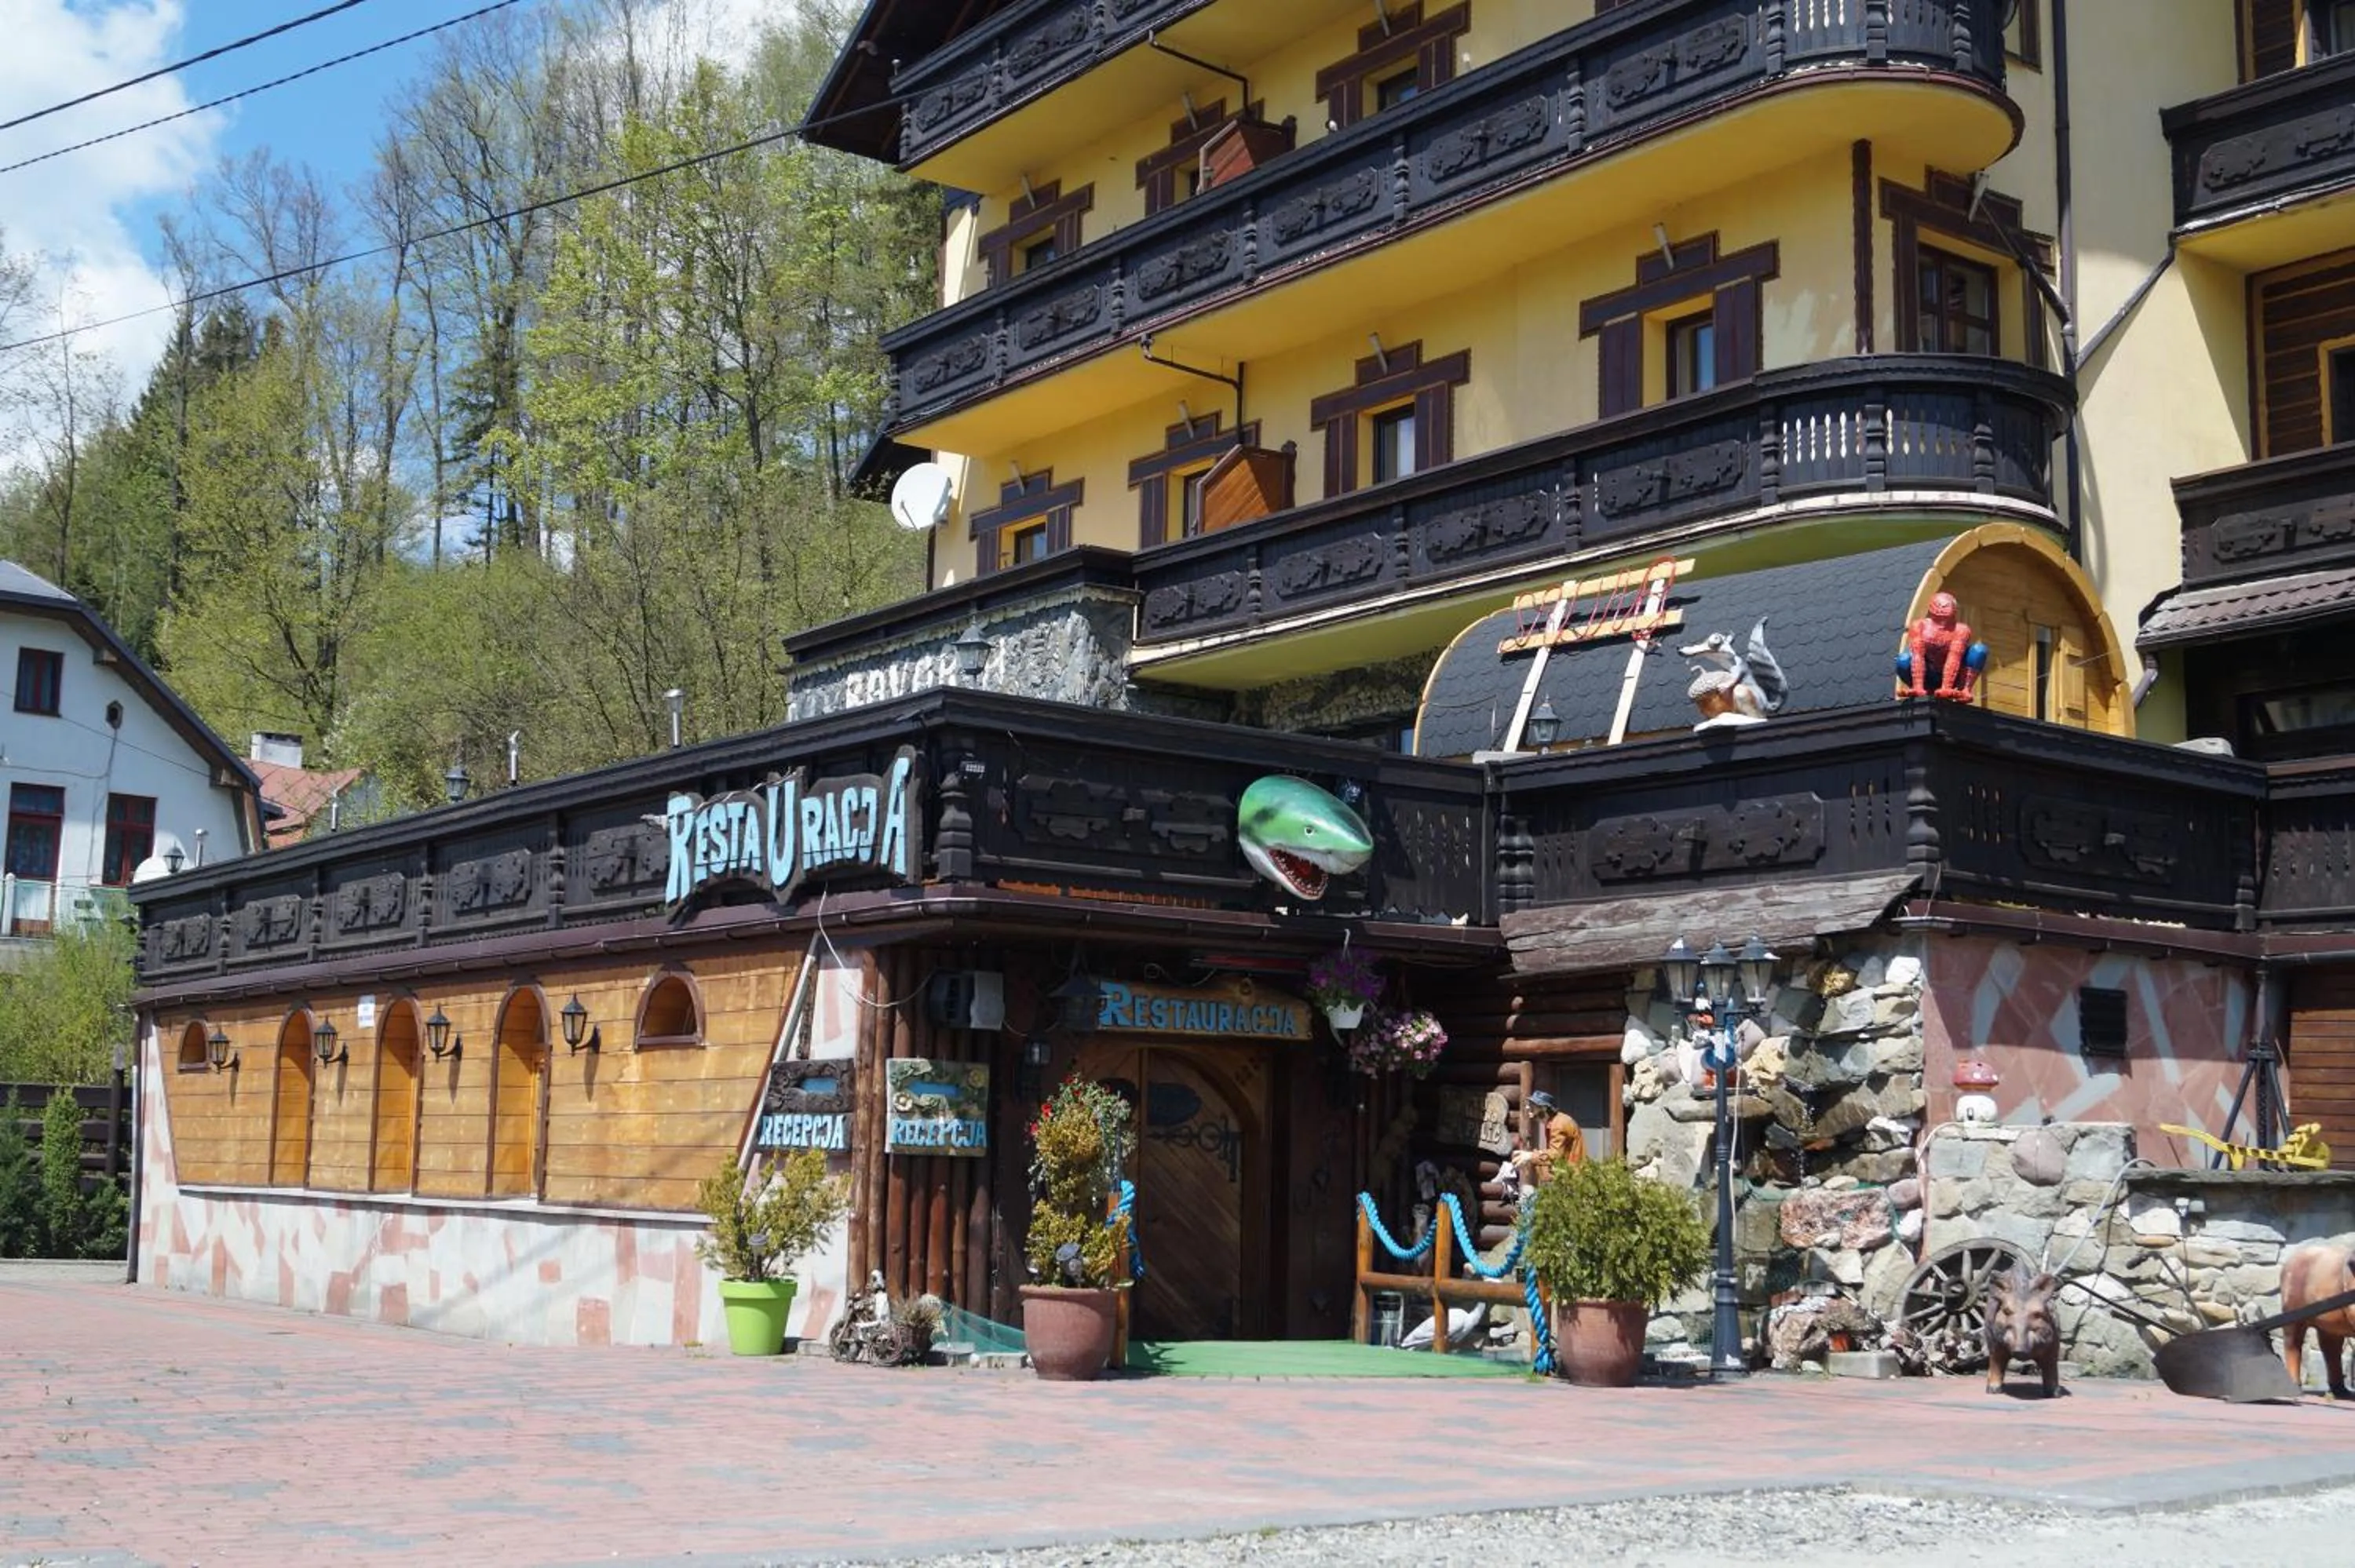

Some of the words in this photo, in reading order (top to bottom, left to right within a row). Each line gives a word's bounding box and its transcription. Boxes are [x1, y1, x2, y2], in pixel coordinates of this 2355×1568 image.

[665, 757, 910, 903] RESTAURACJA
[1098, 980, 1296, 1036] RESTAURACJA
[758, 1114, 846, 1149] RECEPCJA
[889, 1117, 988, 1148] RECEPCJA
